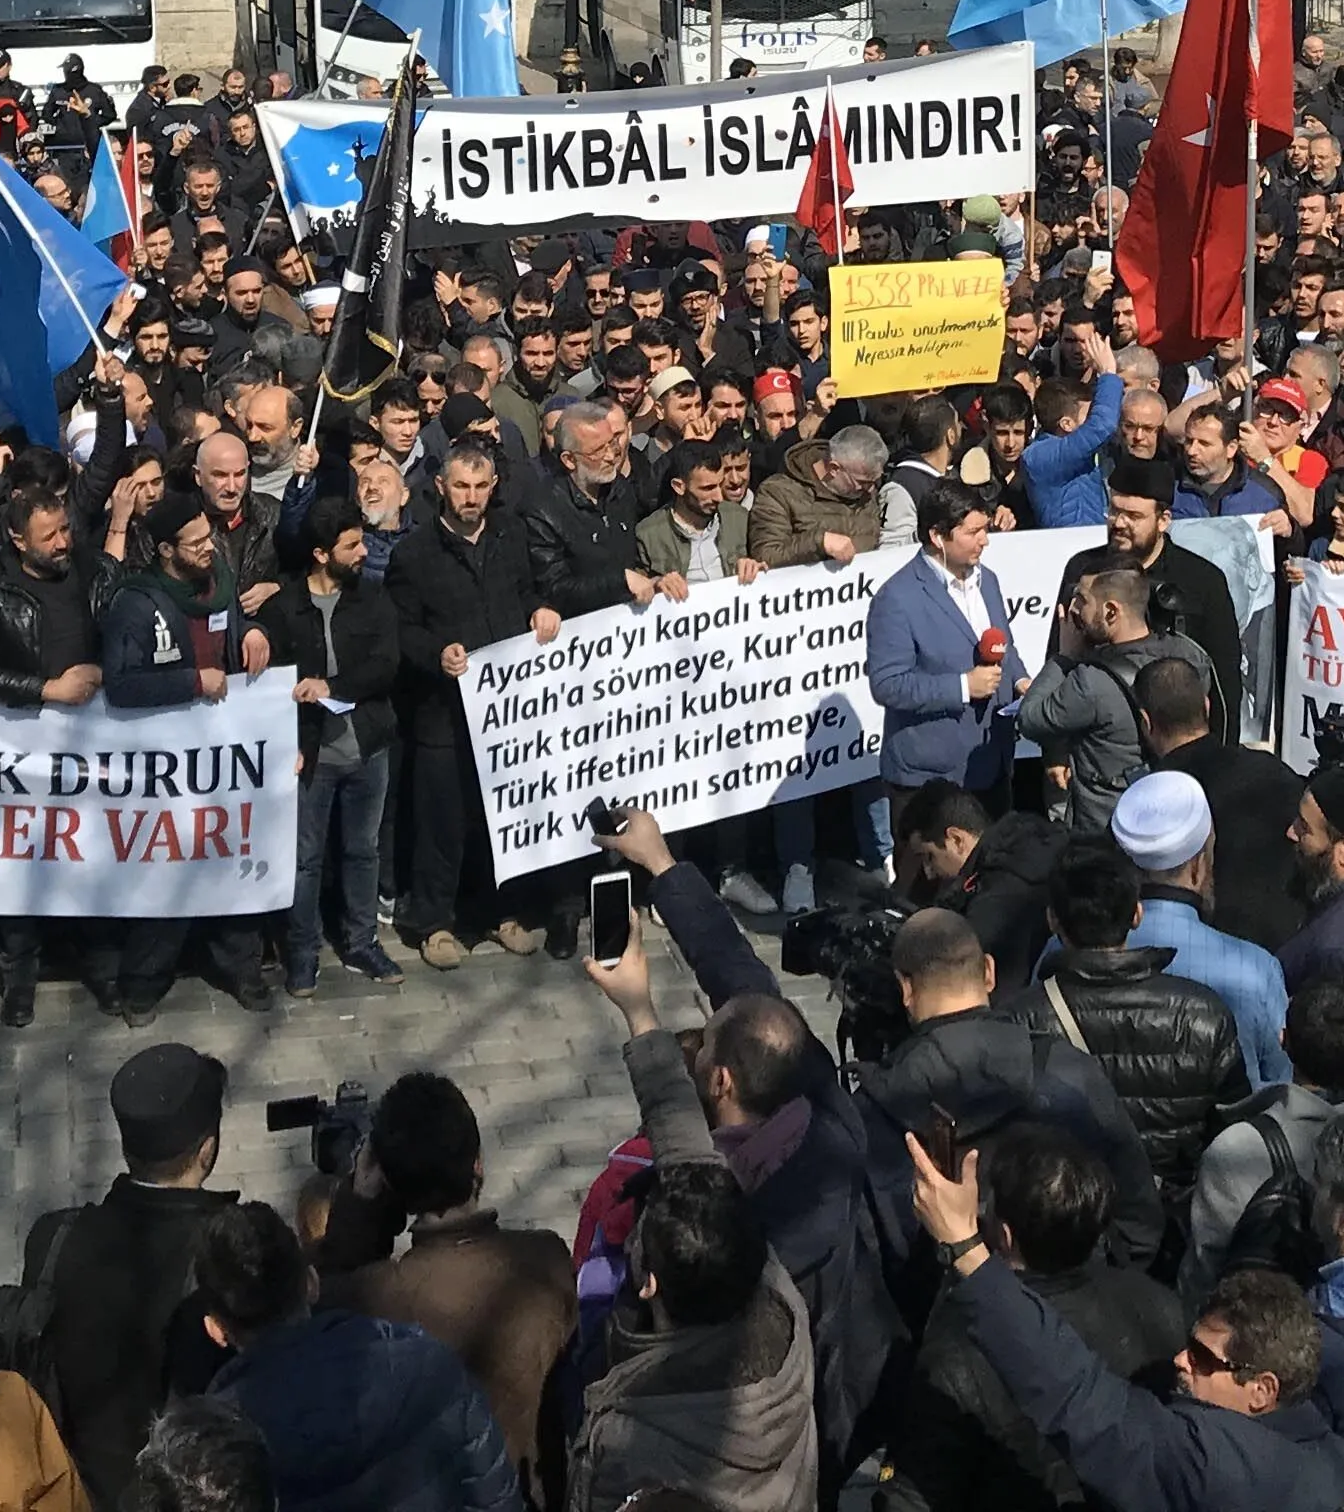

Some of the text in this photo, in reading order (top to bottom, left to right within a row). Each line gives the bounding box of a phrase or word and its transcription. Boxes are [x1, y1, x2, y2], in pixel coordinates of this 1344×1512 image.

[763, 47, 797, 55] ISUZU
[442, 110, 686, 201] İSTİKBÂL
[844, 272, 912, 307] 1538
[476, 572, 875, 694] Ayasofya'yı kapalı tutmak
[482, 683, 584, 734] Allah'a
[593, 649, 734, 701] sövmeye,
[744, 620, 863, 664] Kur'ana
[48, 739, 268, 798] DURUN
[486, 729, 553, 774] Türk
[560, 695, 672, 751] tarihini
[681, 676, 792, 720] kubura
[492, 706, 847, 814] Türk iffetini kirletmeye,
[103, 802, 252, 863] VAR!
[497, 811, 563, 855] Türk
[707, 744, 839, 796] satmaya
